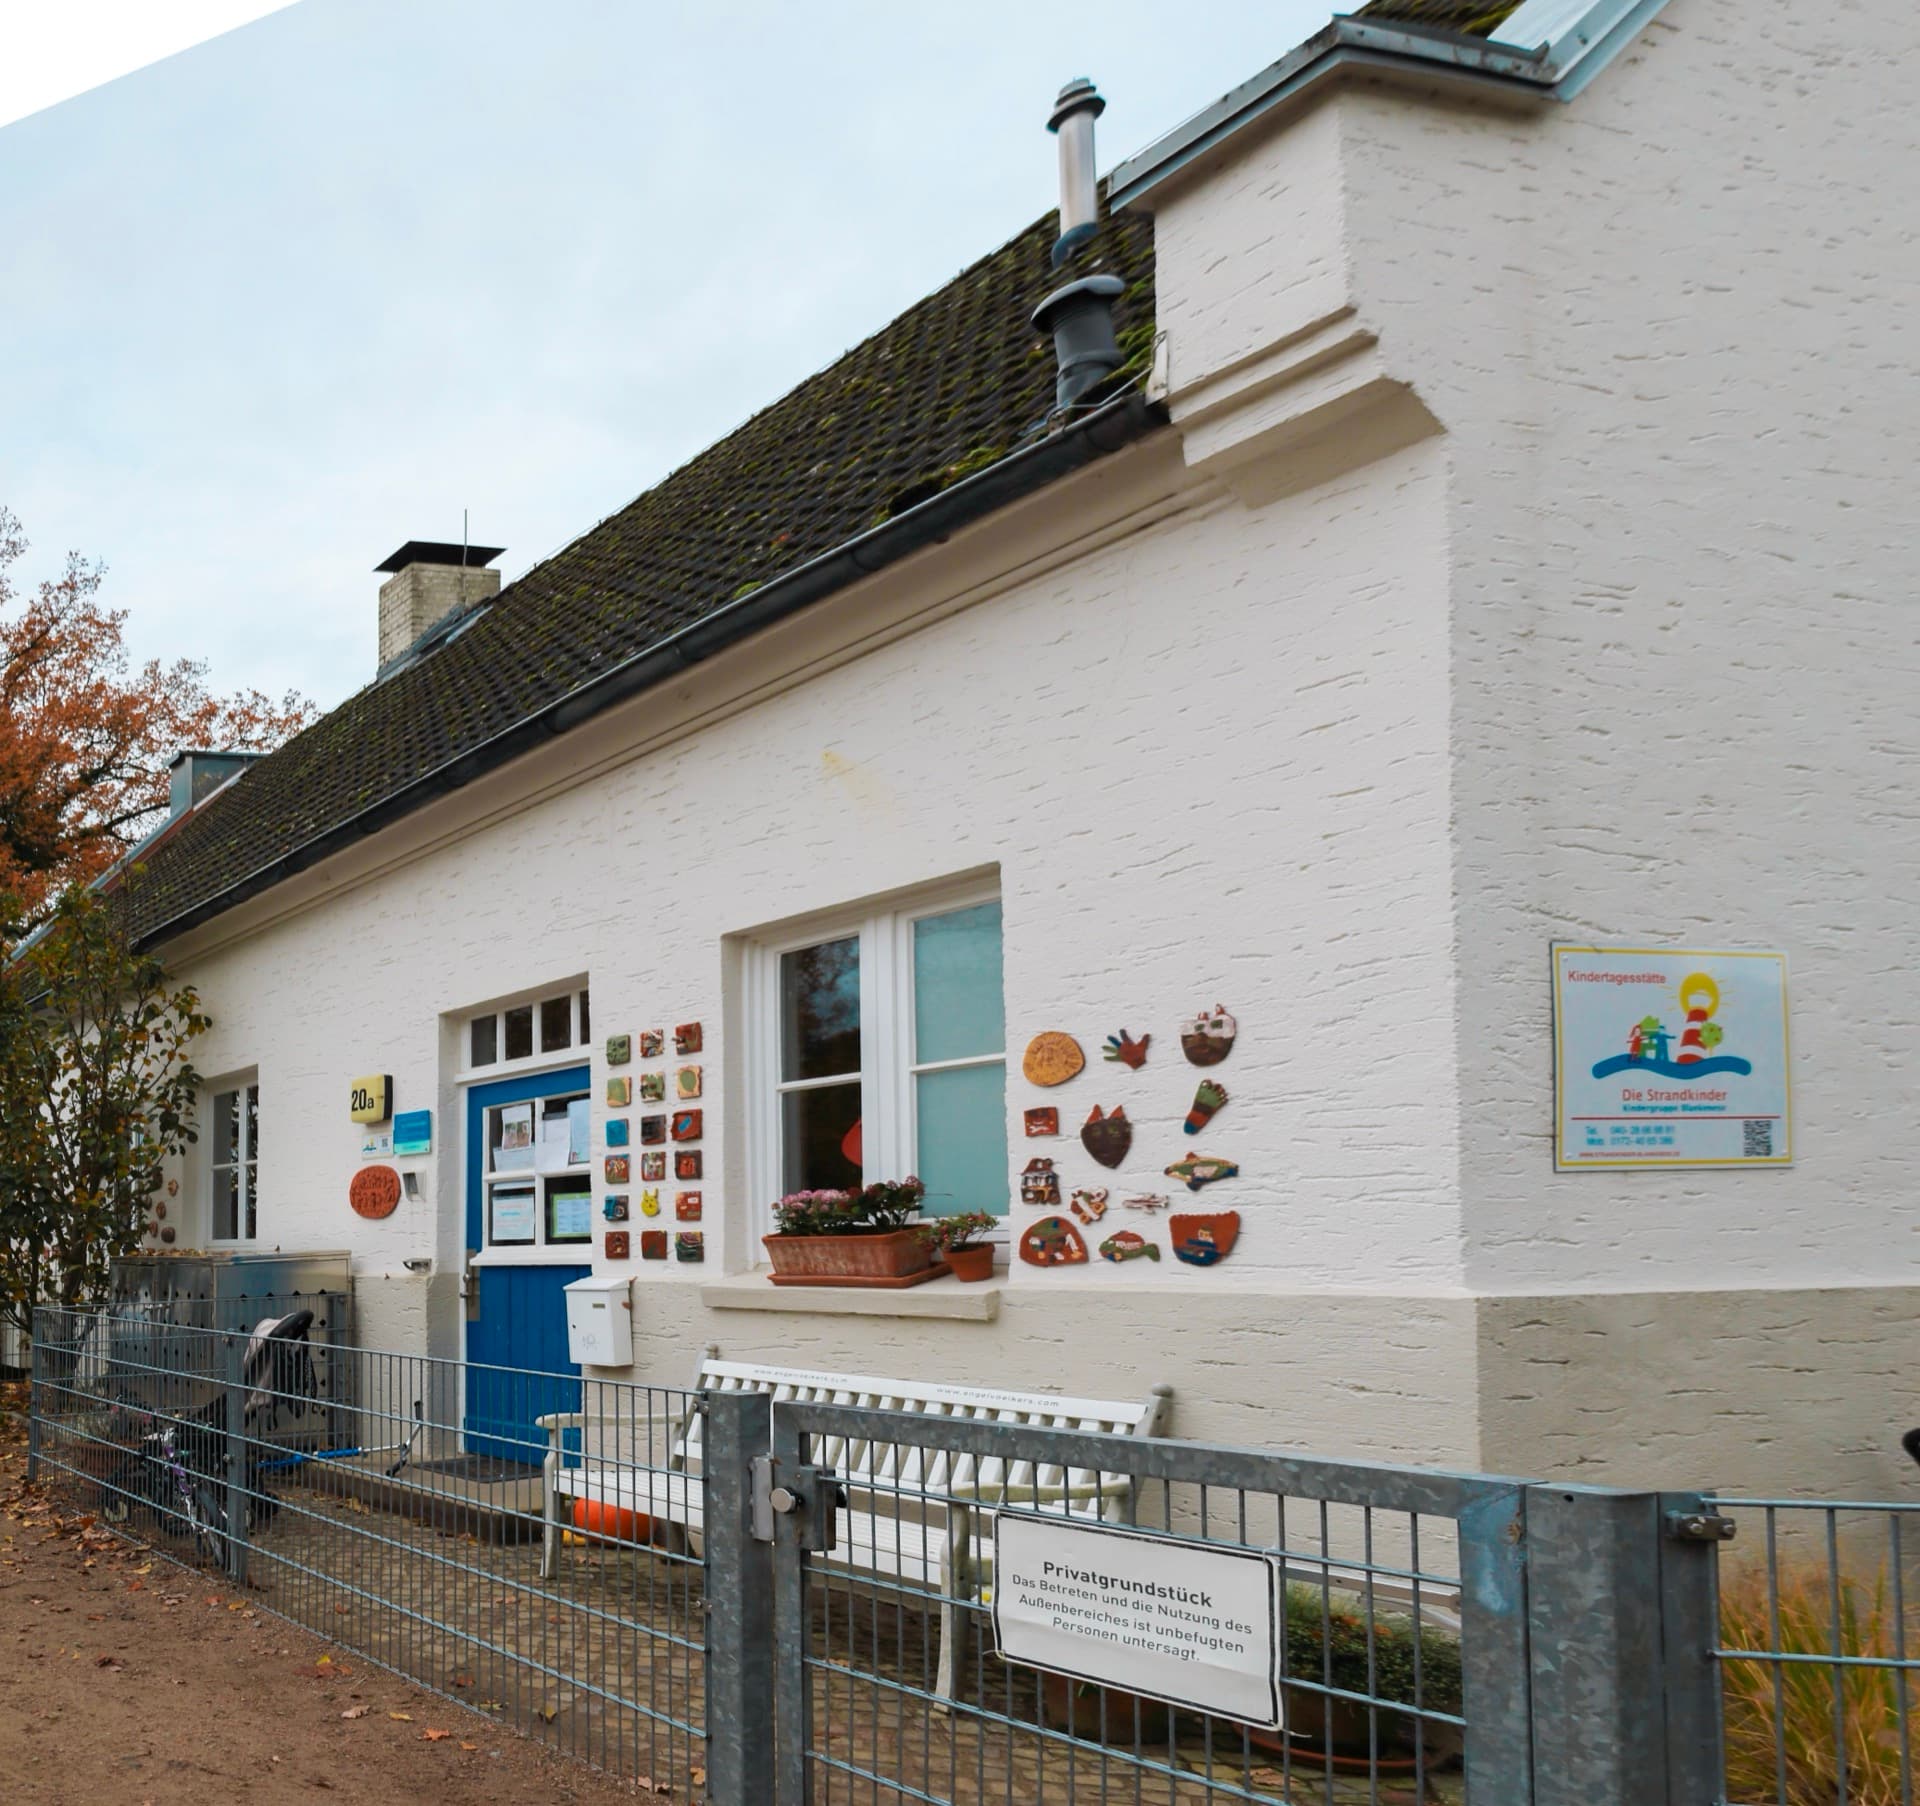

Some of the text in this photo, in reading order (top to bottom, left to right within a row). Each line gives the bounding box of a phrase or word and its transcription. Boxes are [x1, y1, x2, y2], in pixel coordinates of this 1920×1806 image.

[1568, 970, 1666, 986] Kindertagesstätte
[351, 1088, 375, 1112] 20a
[1622, 1088, 1728, 1101] Die Strandkinder
[1012, 1574, 1253, 1635] Das Betreten und die Nutzung des
[1043, 1561, 1213, 1608] Privatgrundstück
[1019, 1594, 1244, 1654] Außenbereiches ist unbefugten
[1053, 1617, 1200, 1661] Personen untersagt.
